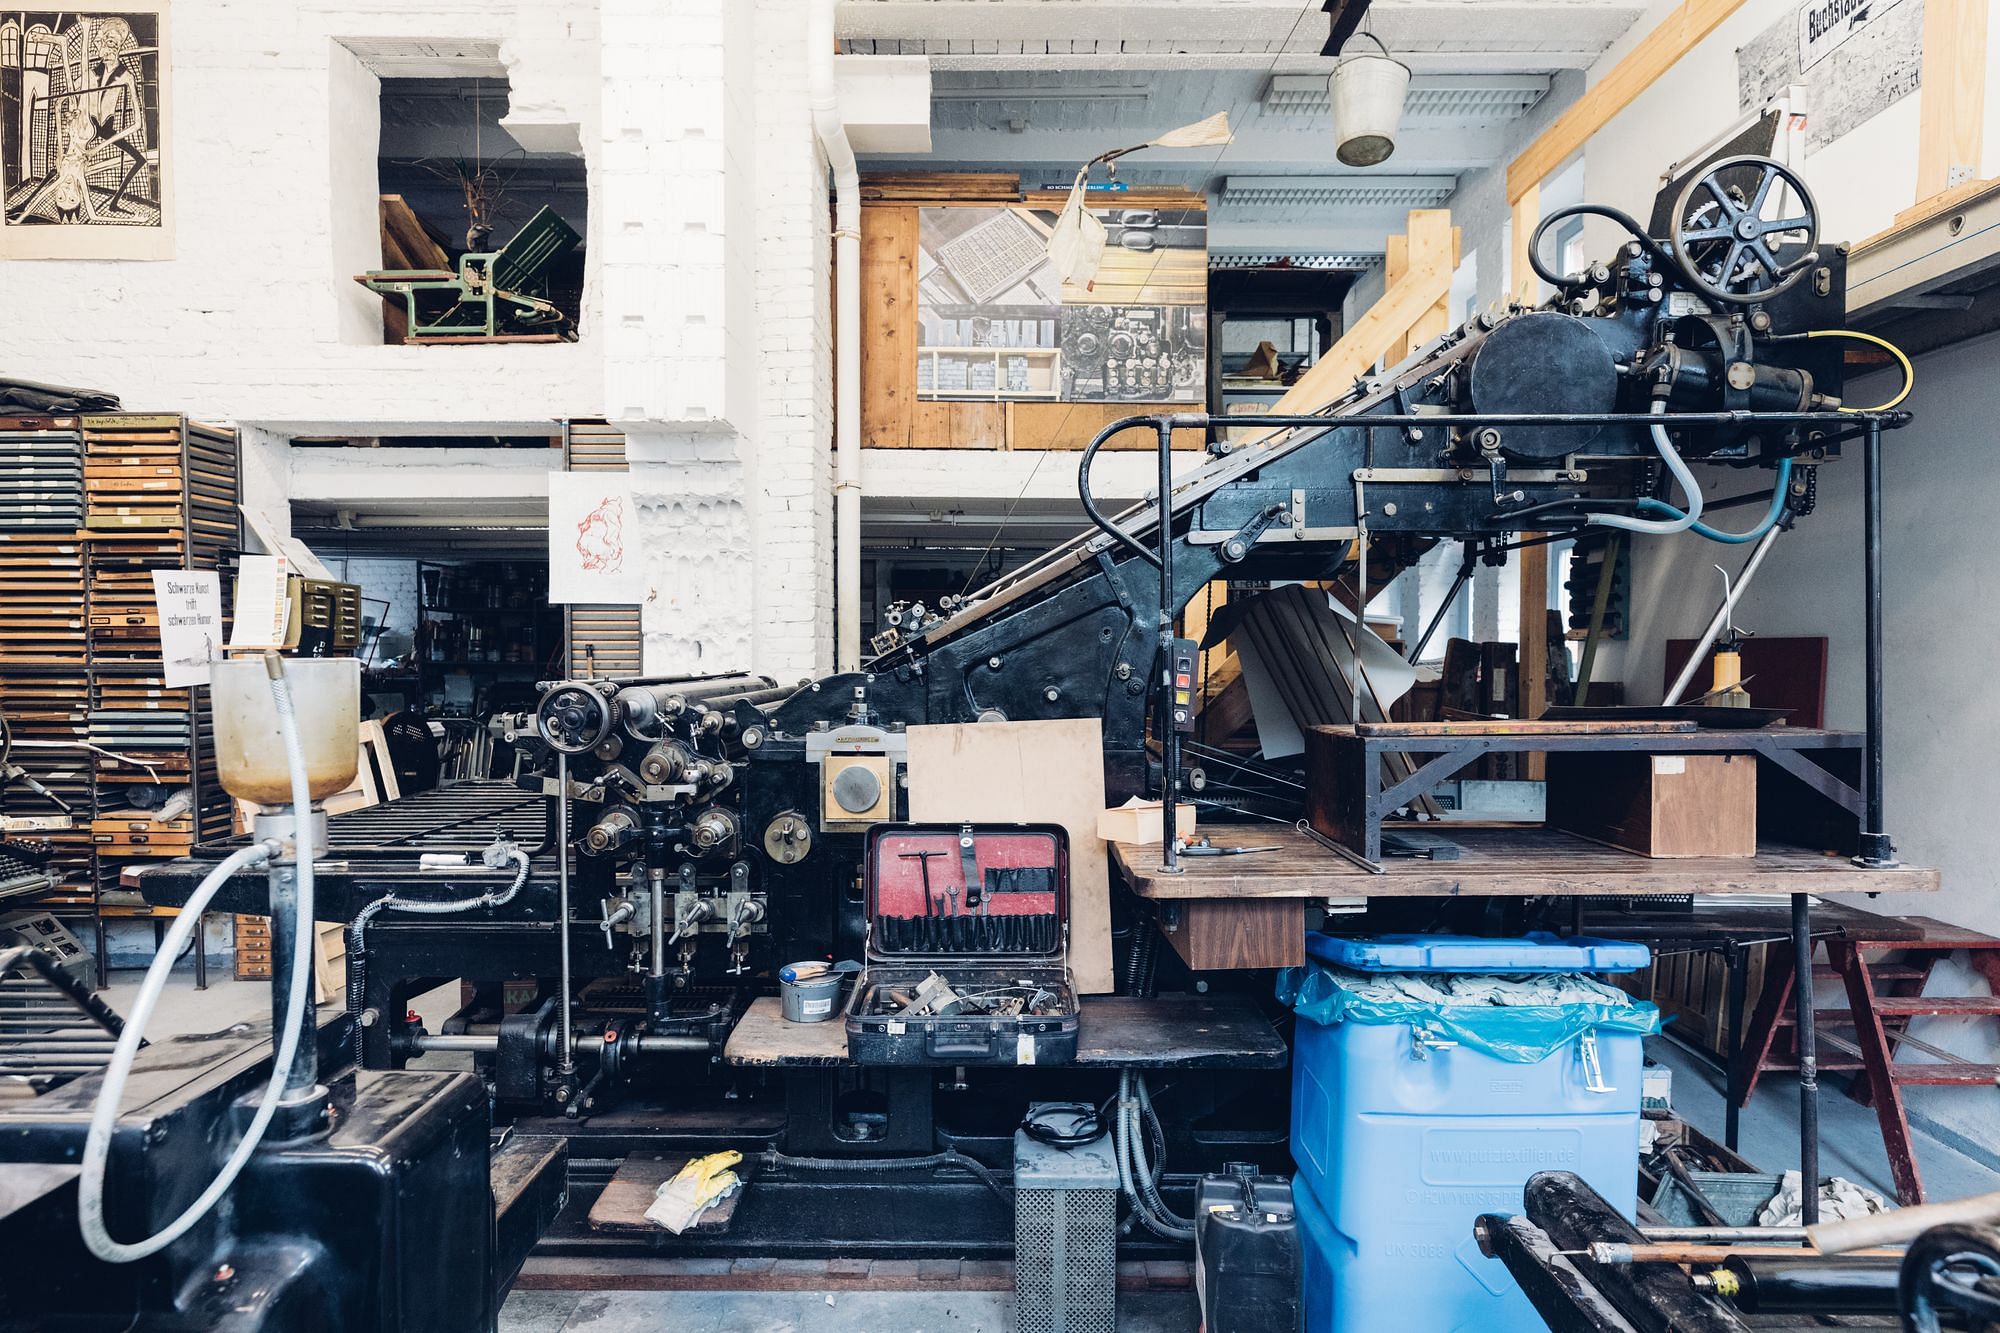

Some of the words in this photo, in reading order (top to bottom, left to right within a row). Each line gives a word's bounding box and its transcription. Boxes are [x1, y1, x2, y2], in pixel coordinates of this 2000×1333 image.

[167, 581, 195, 594] Schwarze
[168, 613, 197, 627] schwarzen
[1430, 1147, 1577, 1167] www.putztextilien.de
